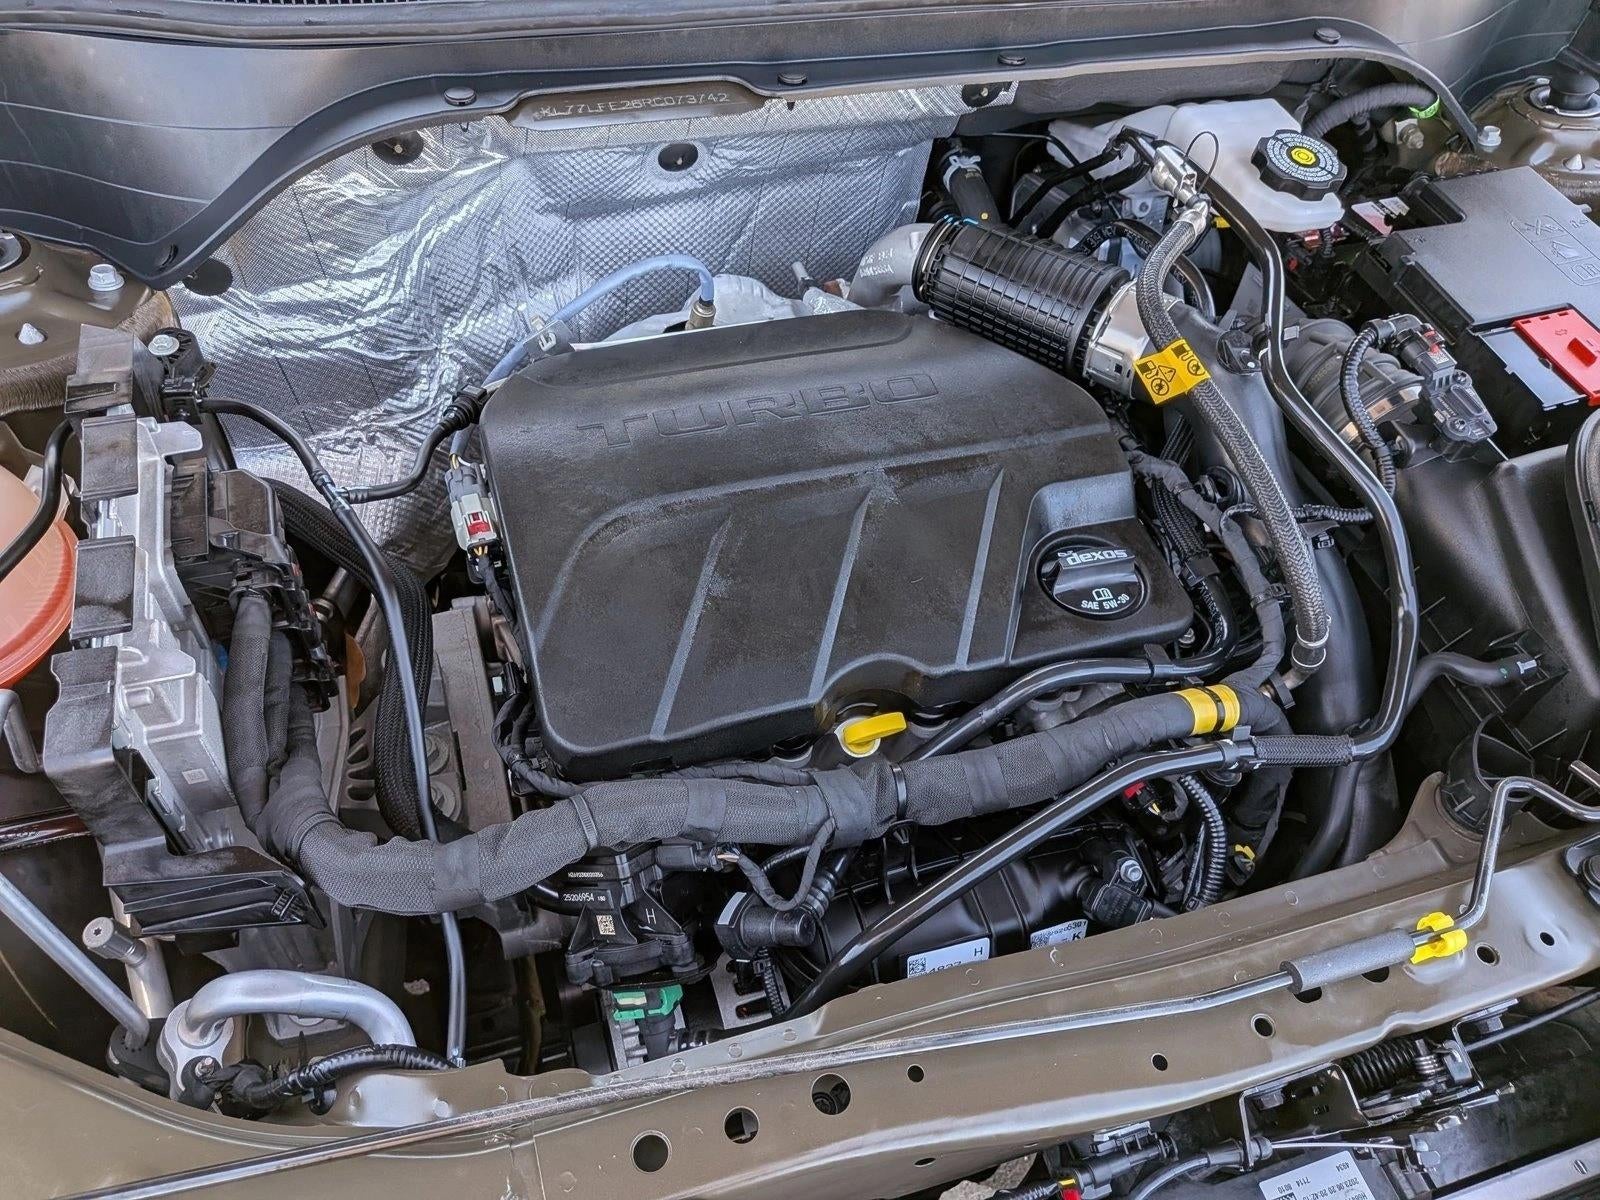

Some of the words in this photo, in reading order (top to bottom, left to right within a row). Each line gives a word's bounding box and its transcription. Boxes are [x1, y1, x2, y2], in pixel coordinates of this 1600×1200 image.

[576, 373, 940, 448] TURBO
[1066, 549, 1128, 566] dexos
[1081, 599, 1100, 610] SAE
[1102, 593, 1130, 610] 5W-30
[645, 908, 657, 925] H
[1072, 930, 1083, 941] K
[974, 946, 984, 957] H
